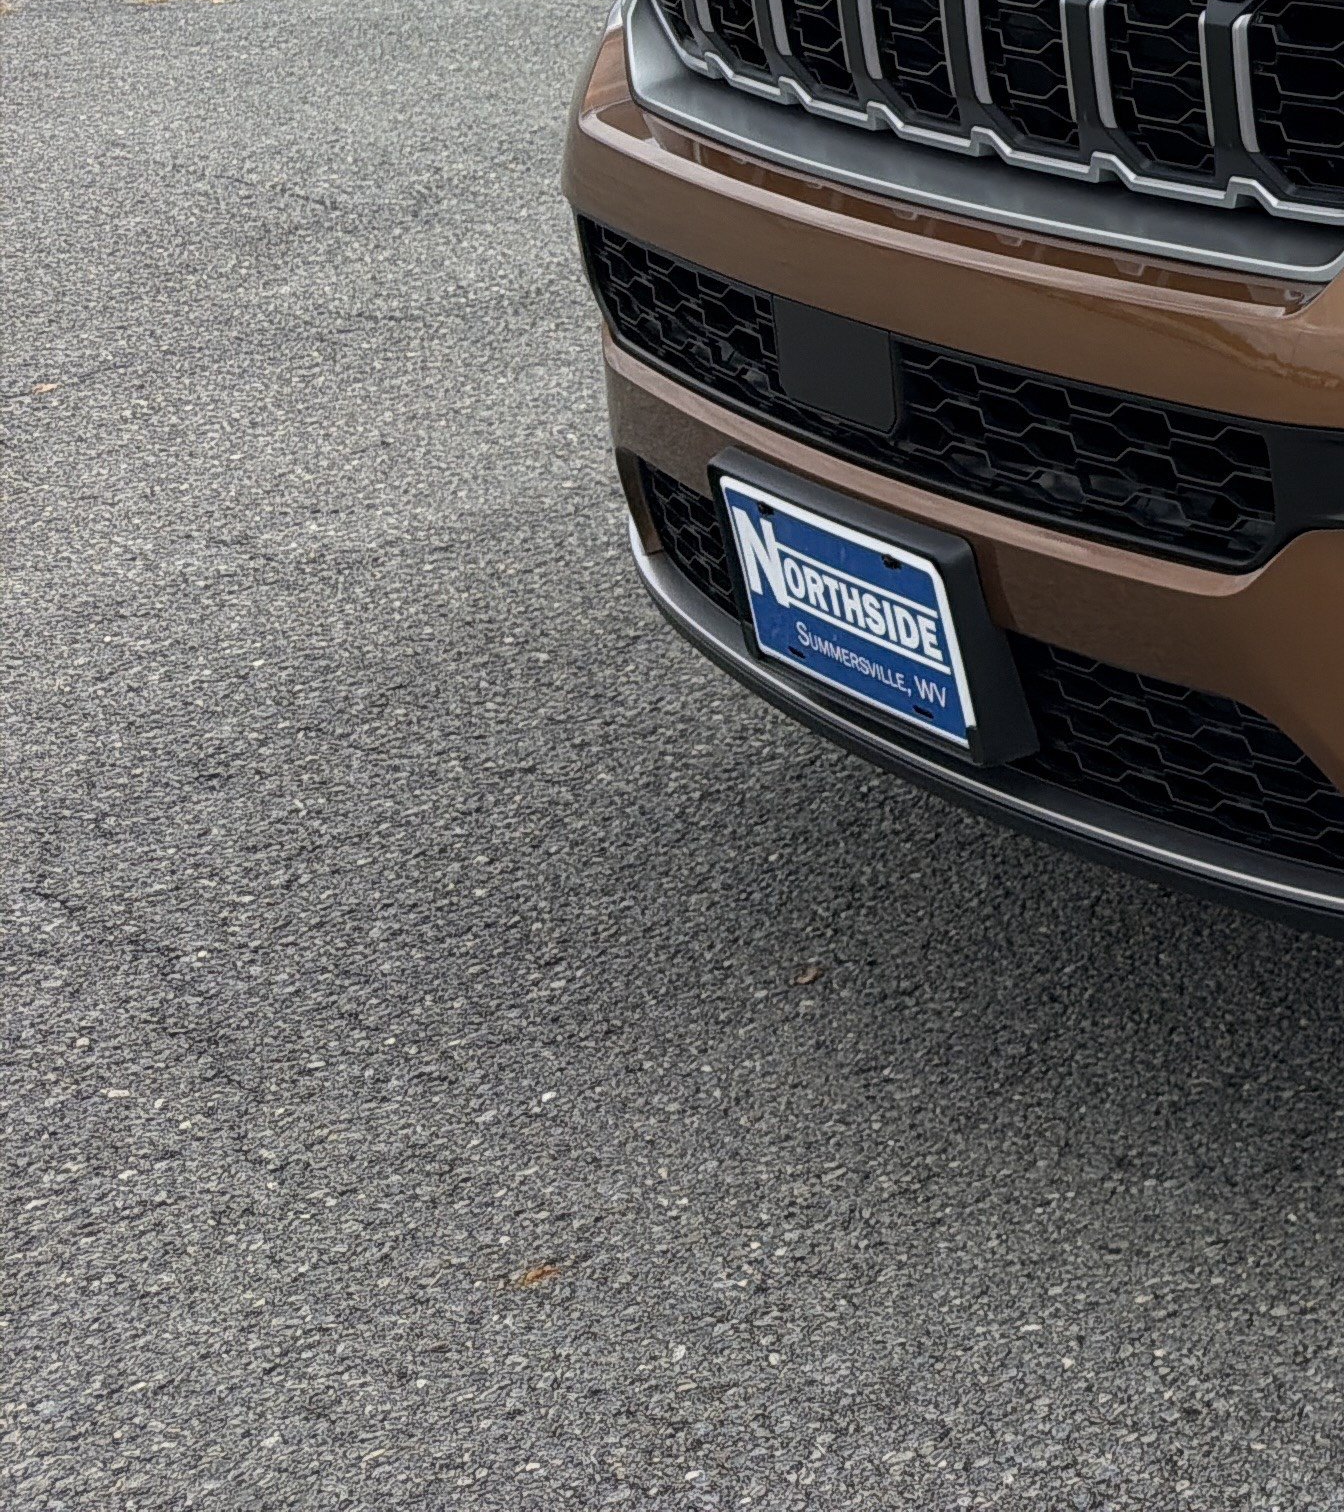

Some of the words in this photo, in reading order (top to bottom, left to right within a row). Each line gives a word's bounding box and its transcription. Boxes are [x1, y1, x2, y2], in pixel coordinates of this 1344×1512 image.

[731, 505, 944, 662] NORTHSIDE
[795, 620, 912, 698] SUMMERSVILLE,
[913, 674, 947, 709] WV
